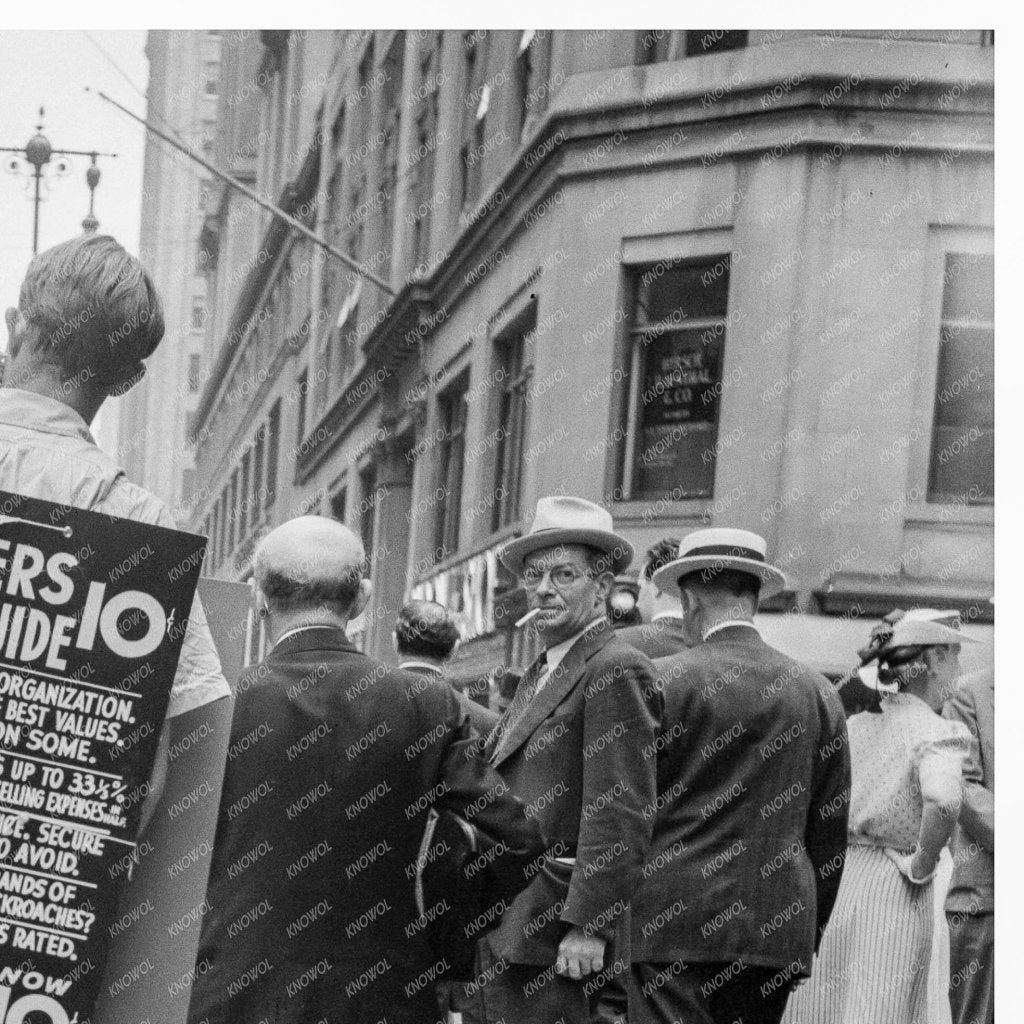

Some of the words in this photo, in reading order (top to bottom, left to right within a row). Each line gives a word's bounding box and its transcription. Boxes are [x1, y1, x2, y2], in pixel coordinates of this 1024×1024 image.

[5, 699, 50, 727] BEST
[55, 710, 125, 747] VALUES.
[26, 729, 96, 764] SOME.
[10, 759, 36, 782] UP
[41, 766, 64, 789] TO
[45, 791, 108, 822] EXPENSES
[36, 823, 108, 856] SECURE
[13, 842, 79, 876] AVOID.
[48, 881, 77, 904] OF
[12, 927, 77, 961] RATED.
